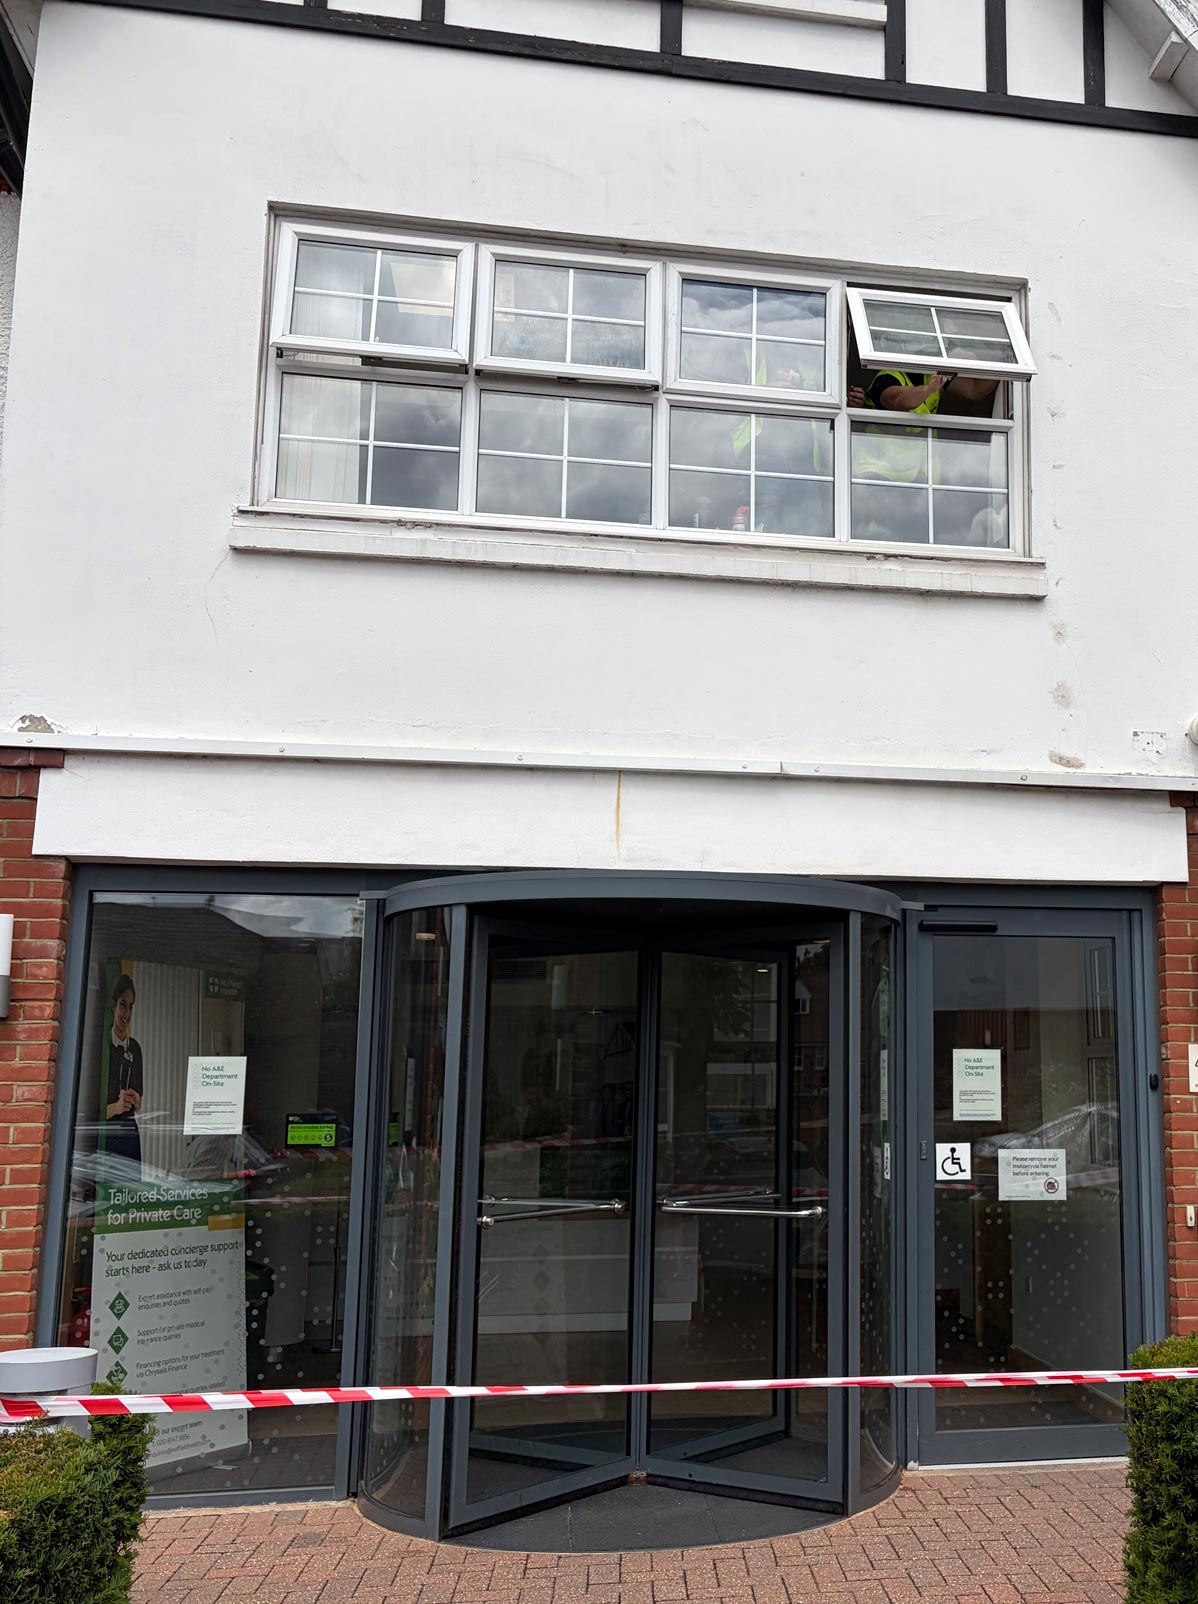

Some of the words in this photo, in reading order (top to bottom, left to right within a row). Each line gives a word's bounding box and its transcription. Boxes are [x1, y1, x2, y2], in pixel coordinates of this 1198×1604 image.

[108, 1187, 157, 1205] Tailored
[160, 1186, 208, 1201] Services
[108, 1210, 127, 1225] for
[128, 1208, 171, 1224] Private
[174, 1205, 202, 1220] Care
[106, 1251, 125, 1262] Your
[127, 1246, 169, 1260] dedicated
[171, 1244, 208, 1257] concierge
[210, 1240, 239, 1253] support
[105, 1266, 130, 1278] starts
[132, 1263, 150, 1274] here
[158, 1261, 172, 1271] ask
[173, 1262, 182, 1270] us
[184, 1258, 207, 1269] today
[156, 1291, 181, 1300] assistance
[167, 1324, 184, 1332] priate
[137, 1336, 162, 1344] insrance
[136, 1360, 161, 1370] Financing
[162, 1358, 181, 1366] options
[190, 1354, 200, 1362] your
[201, 1349, 224, 1358] treatment
[168, 1364, 188, 1372] Finance
